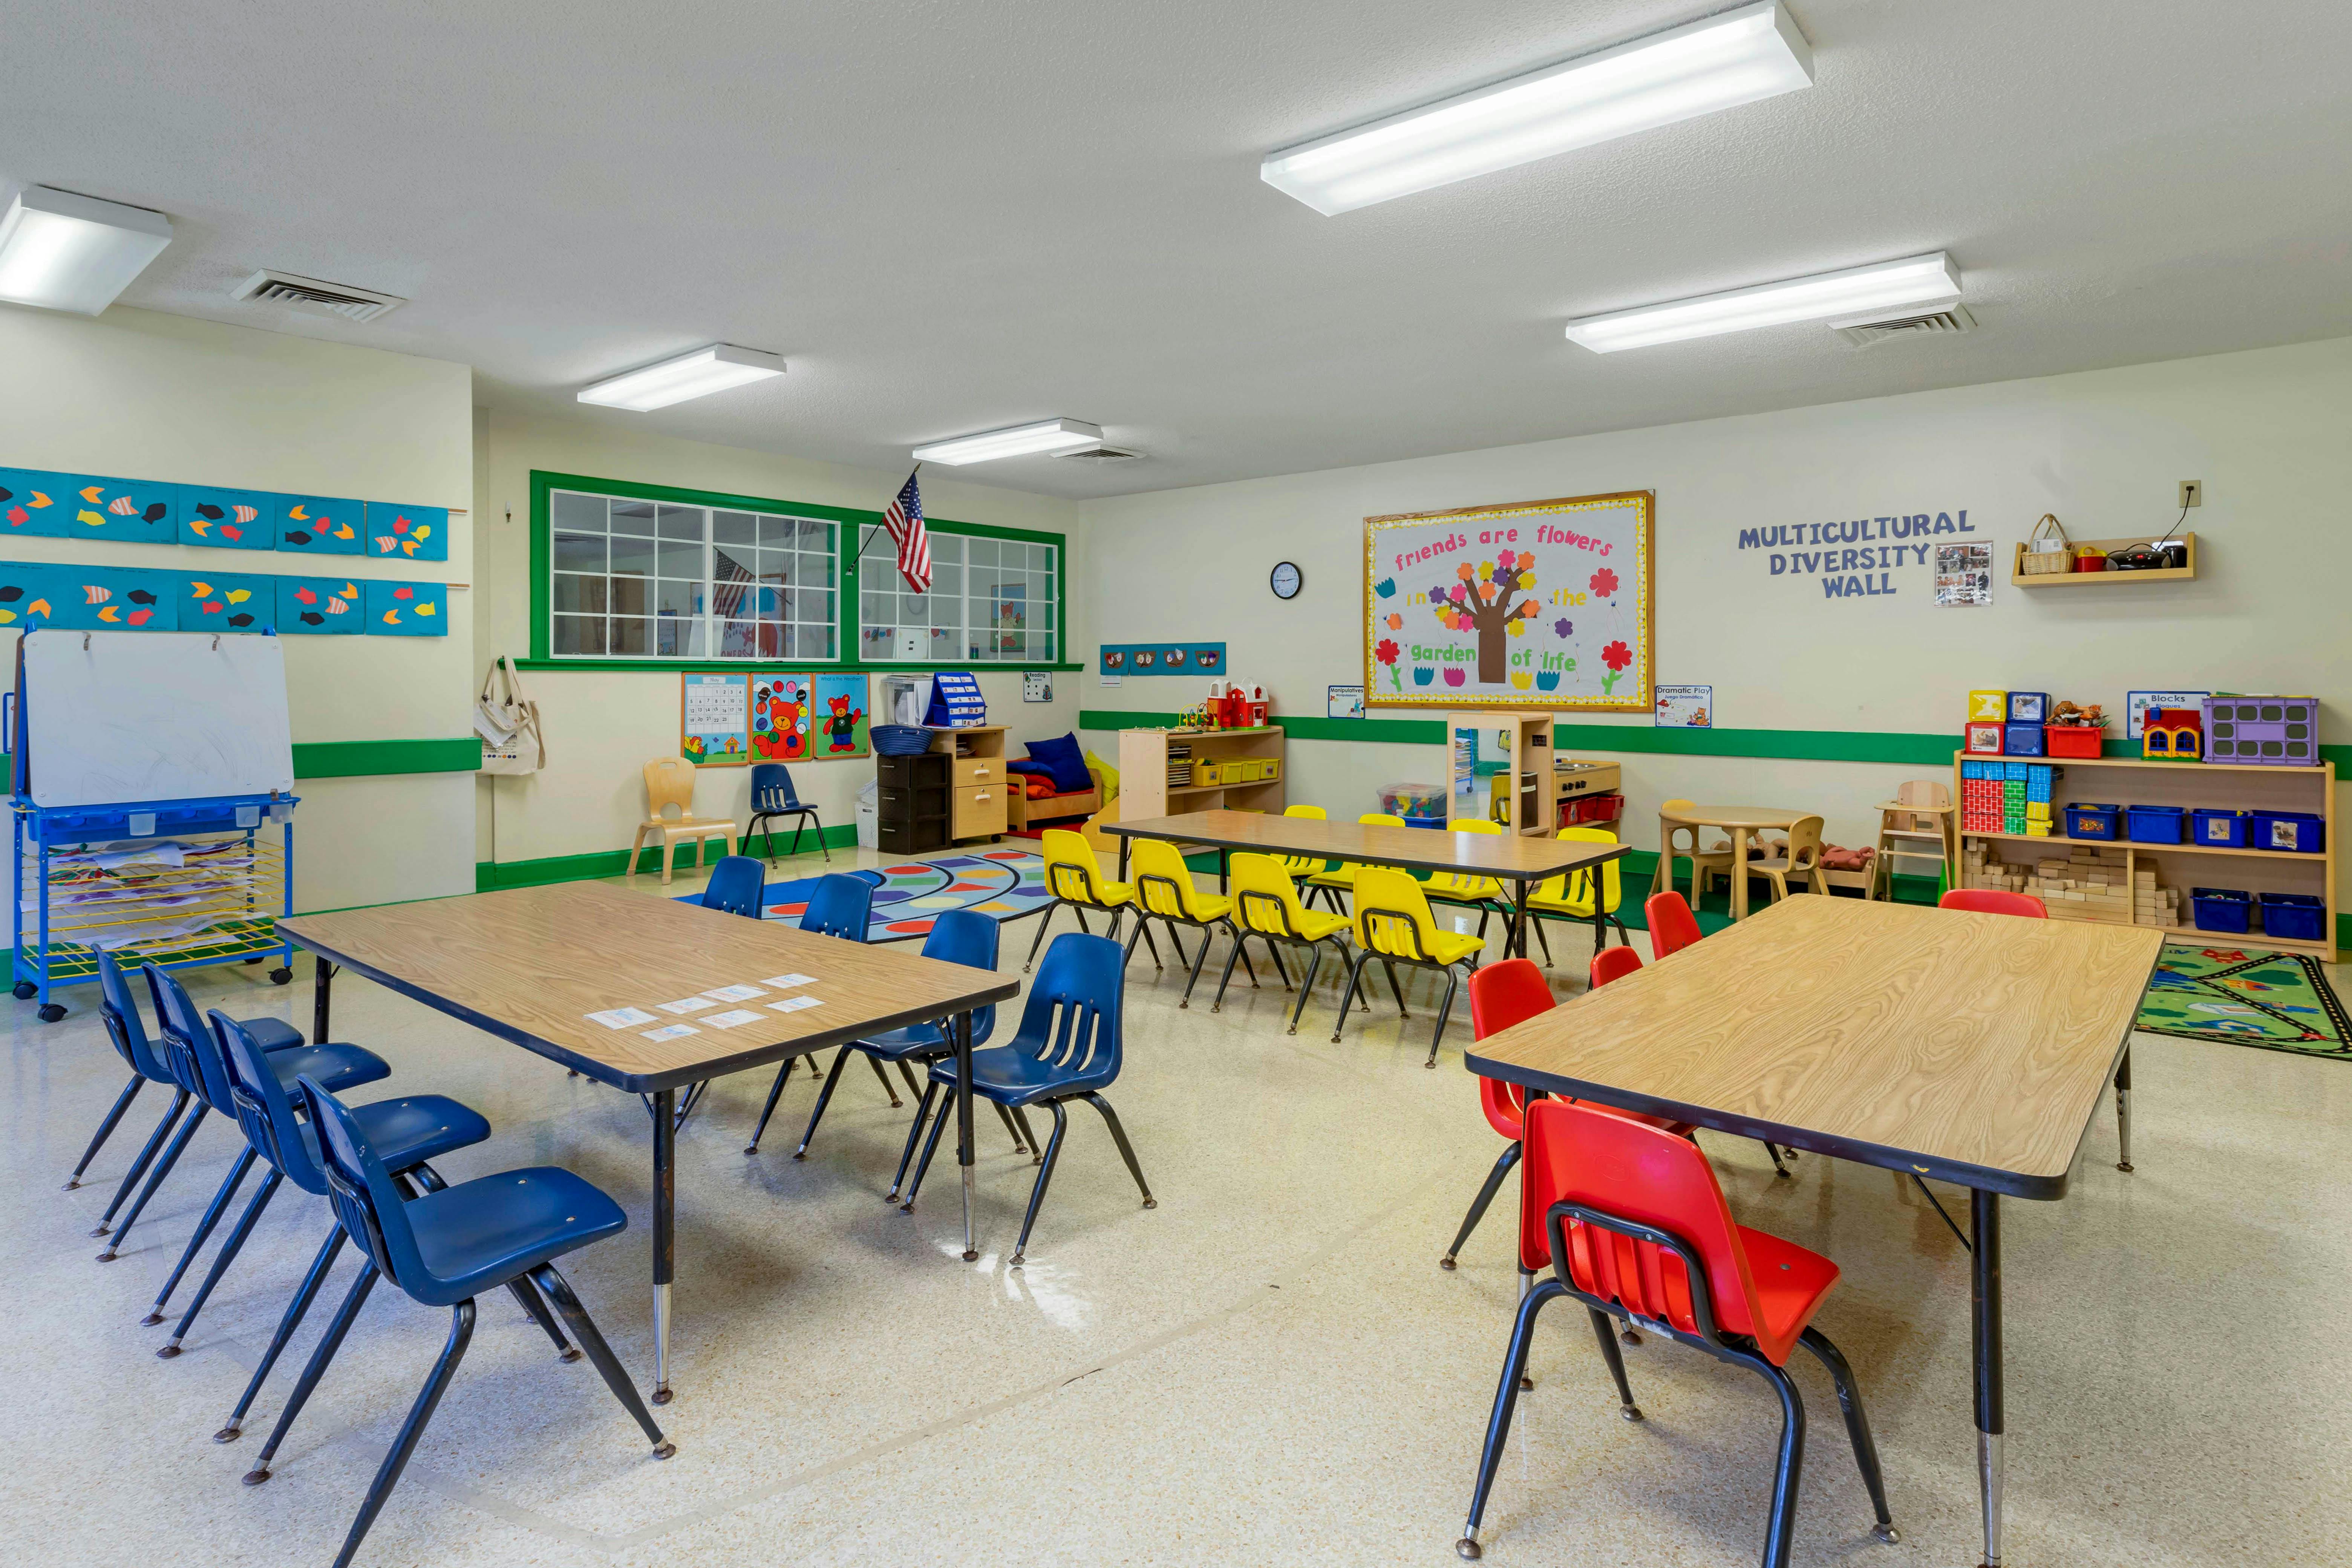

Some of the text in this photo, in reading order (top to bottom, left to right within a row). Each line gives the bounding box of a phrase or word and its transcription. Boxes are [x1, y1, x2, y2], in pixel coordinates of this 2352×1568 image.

[1738, 510, 1975, 549] MULTICULTURAL
[1395, 525, 1613, 571] friends are flowers
[1770, 543, 1931, 575] DIVERSITY
[1407, 588, 1586, 606] in the
[1821, 573, 1897, 598] WALL
[1411, 644, 1576, 671] garden of life
